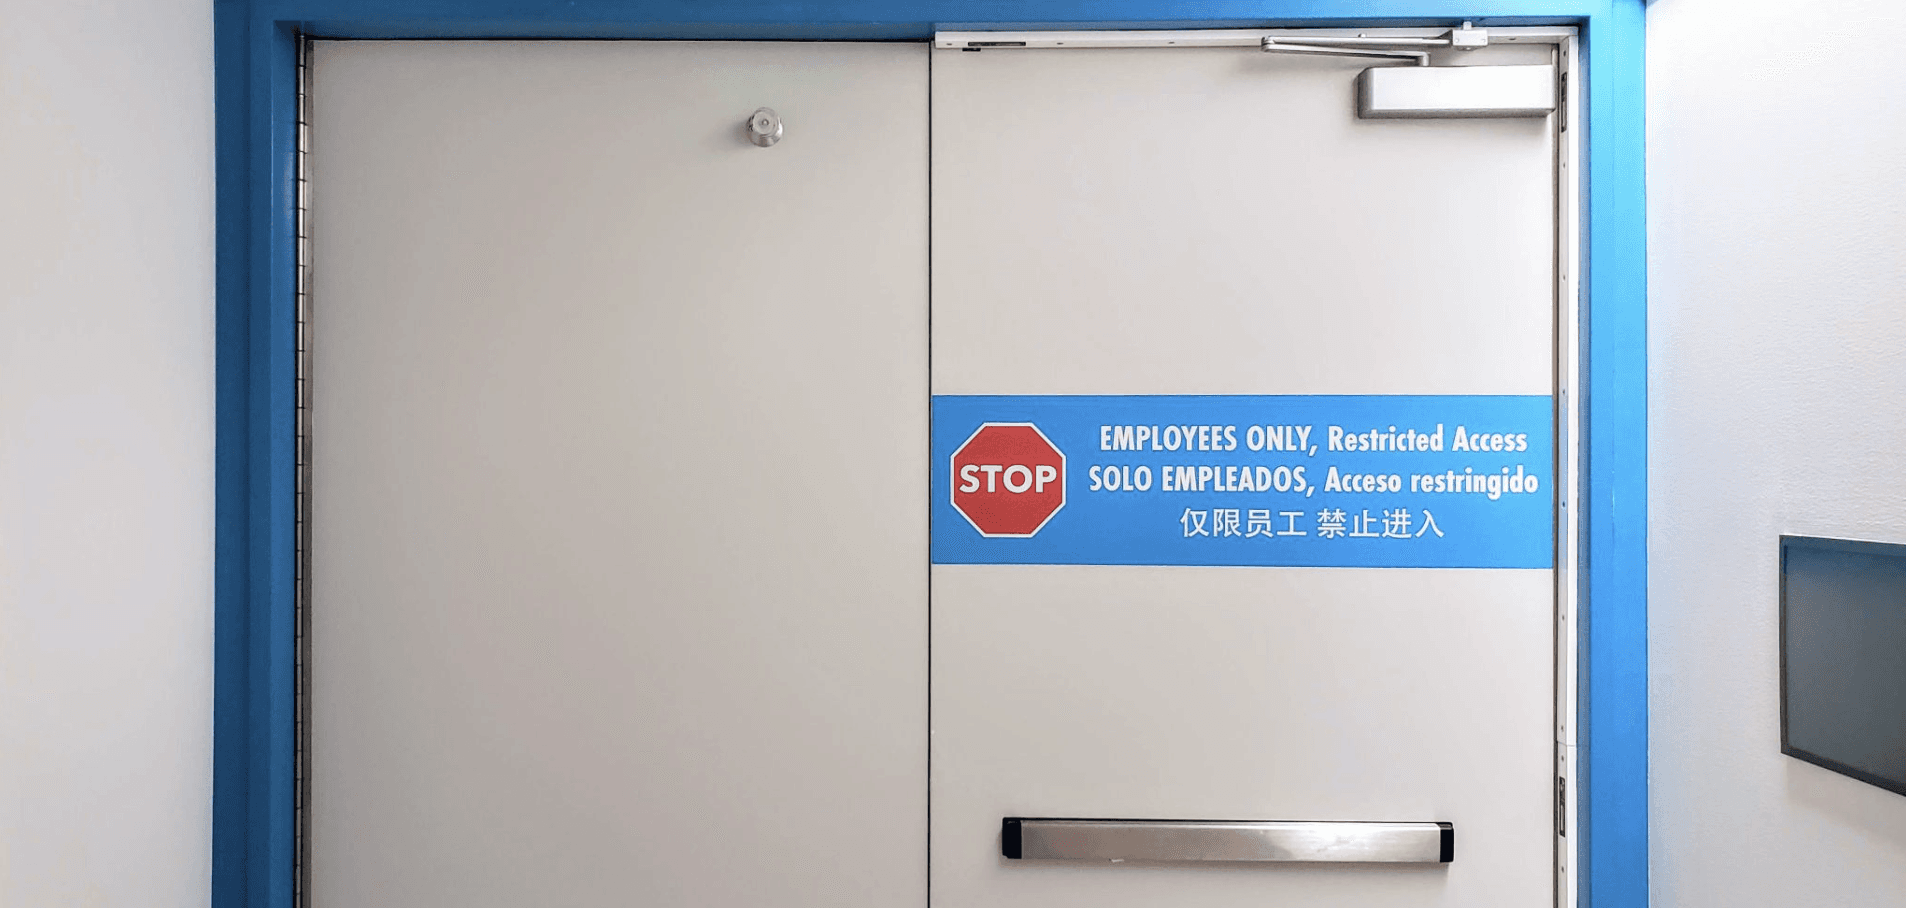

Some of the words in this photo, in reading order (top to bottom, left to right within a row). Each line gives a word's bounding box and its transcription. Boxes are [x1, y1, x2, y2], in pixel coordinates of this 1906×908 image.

[1100, 425, 1237, 451] EMPLOYEES
[1246, 425, 1317, 456] ONLY,
[1328, 424, 1443, 451] Restricted
[1452, 426, 1527, 452] Access
[959, 464, 1057, 494] STOP
[1089, 466, 1151, 491] SOLO
[1162, 466, 1314, 497] EMPLEADOS,
[1325, 467, 1401, 492] Acceso
[1411, 465, 1538, 499] restringido
[1180, 508, 1307, 538] 仅限员工
[1317, 509, 1444, 539] 禁止进入
